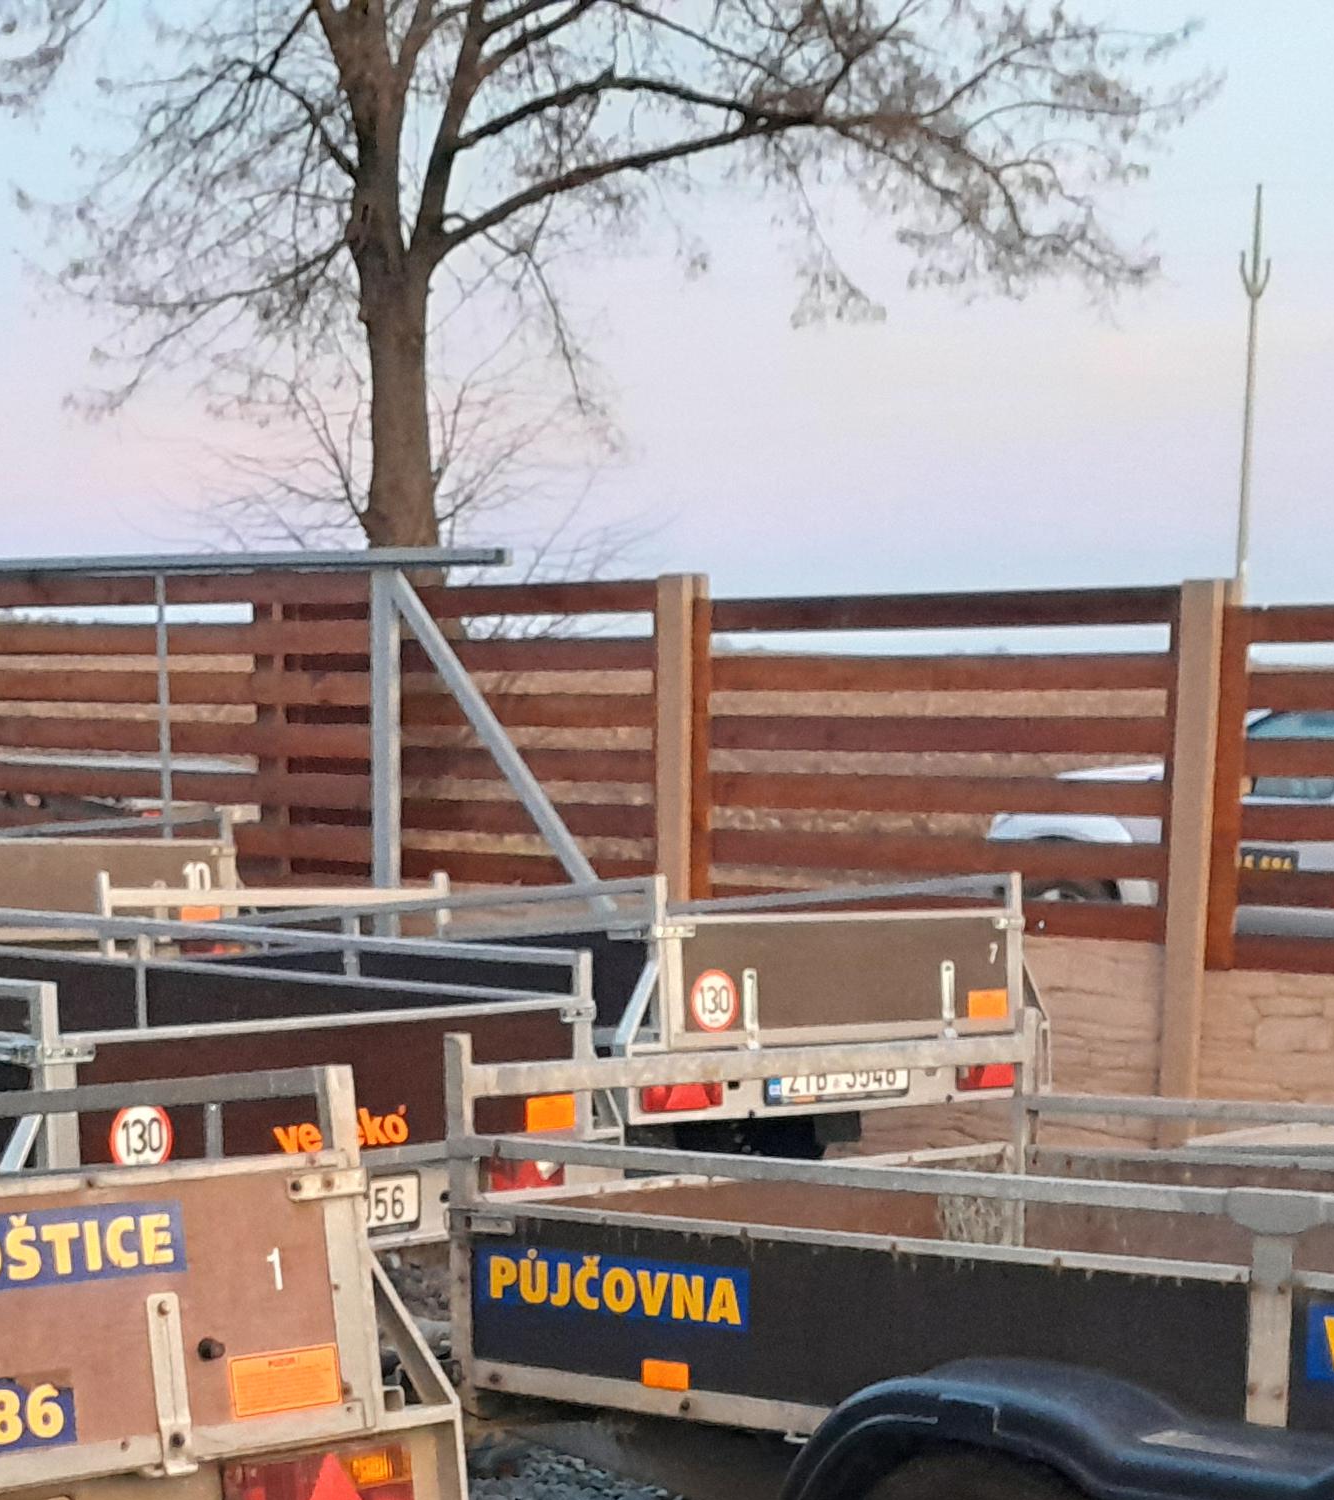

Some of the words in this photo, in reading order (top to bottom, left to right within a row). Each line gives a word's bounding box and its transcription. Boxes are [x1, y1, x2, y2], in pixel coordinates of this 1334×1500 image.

[183, 862, 211, 890] 10
[700, 985, 730, 1014] 130
[121, 1117, 163, 1157] 130
[273, 1107, 409, 1154] veko
[366, 1184, 405, 1223] 56
[267, 1247, 284, 1290] 1
[489, 1248, 742, 1325] PŮJČOVNA
